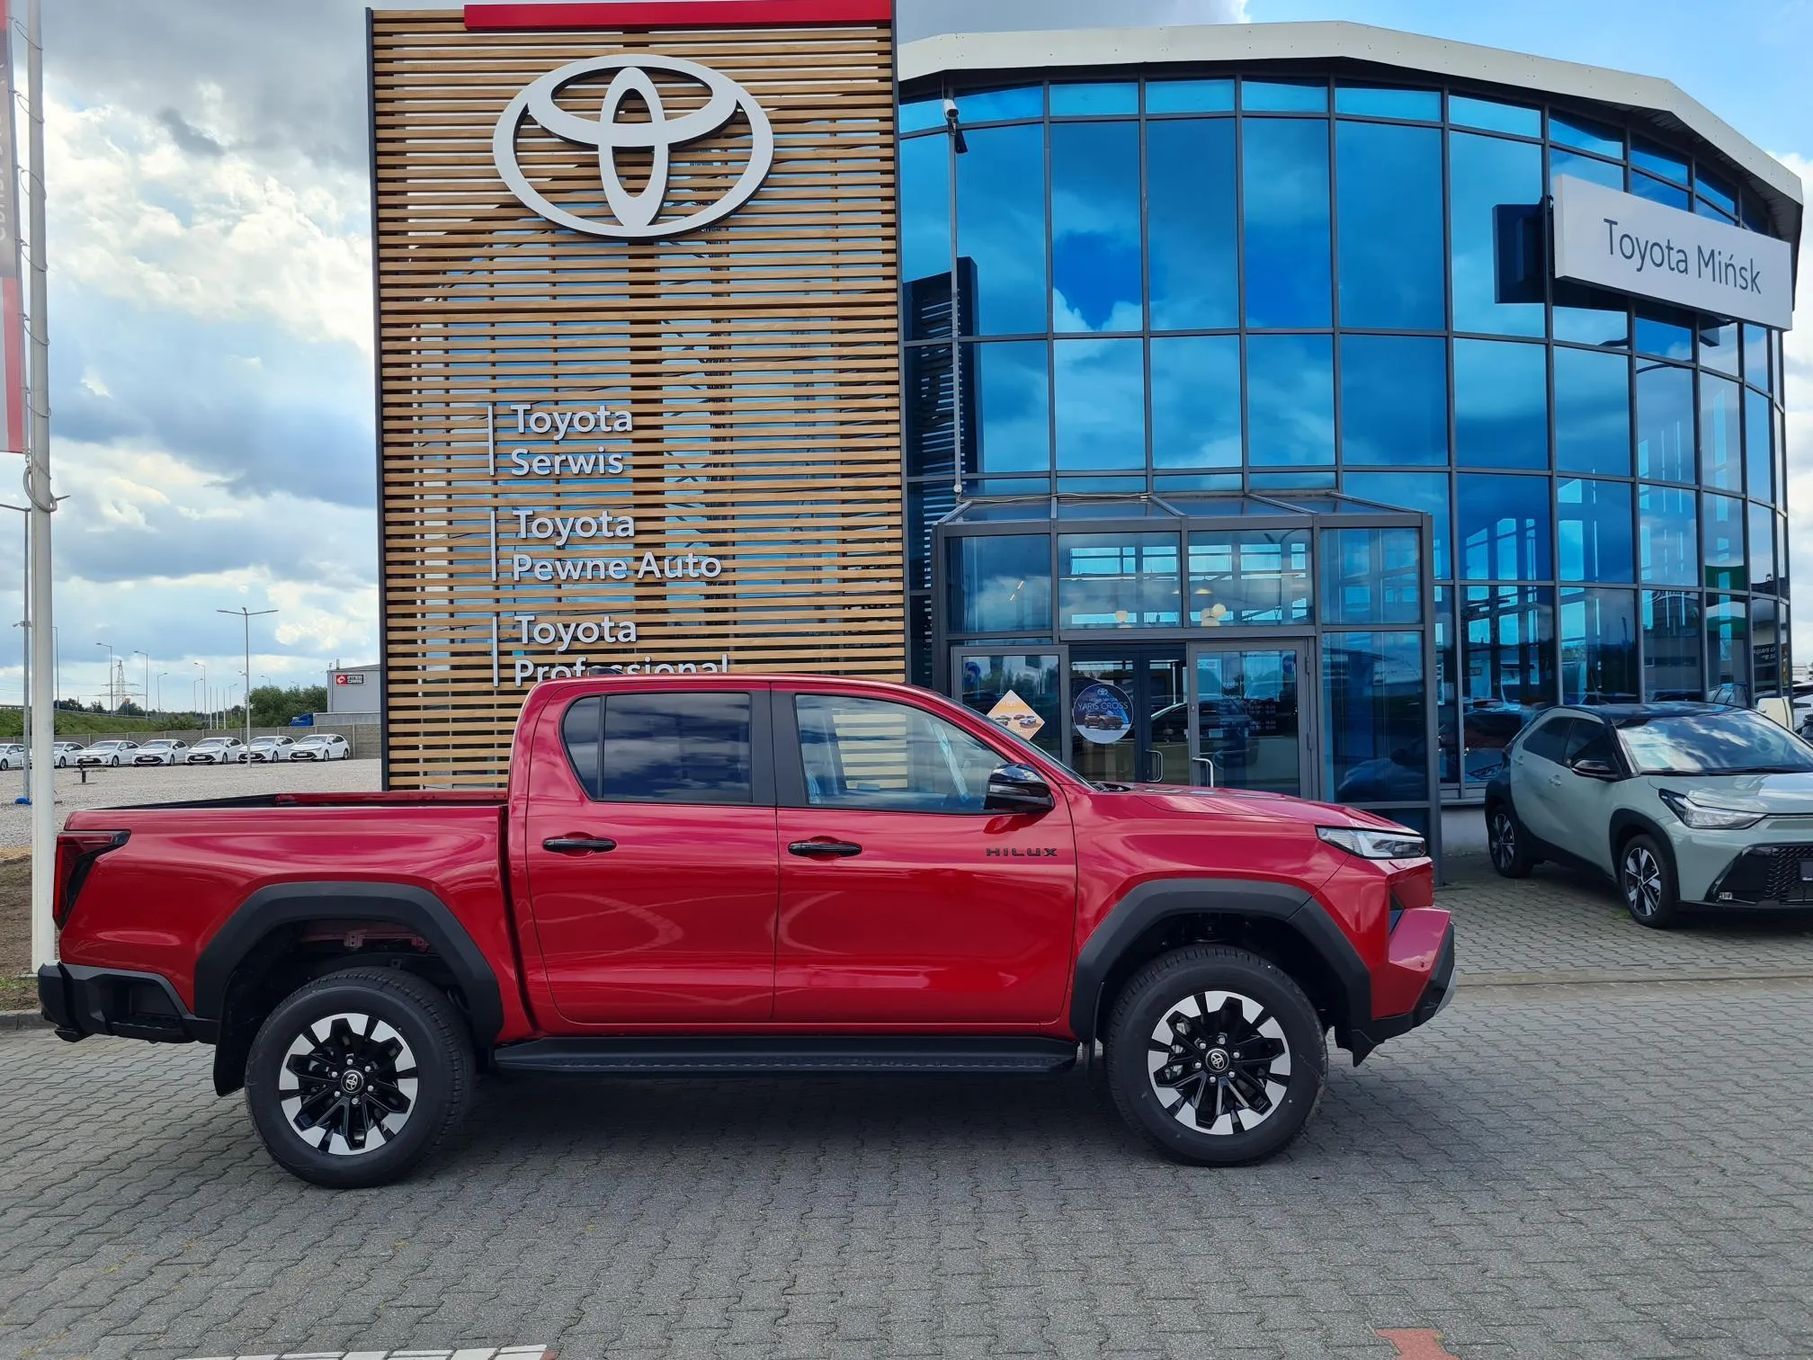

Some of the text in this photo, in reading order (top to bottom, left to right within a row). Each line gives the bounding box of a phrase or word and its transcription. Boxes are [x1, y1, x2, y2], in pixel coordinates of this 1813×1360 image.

[1603, 217, 1762, 295] Toyota Mińsk
[510, 404, 634, 440] Toyota
[510, 446, 624, 476] Serwis
[512, 509, 636, 546] Toyota
[512, 551, 722, 582] Pewne Auto
[513, 615, 638, 651] Toyota
[514, 653, 728, 687] Profsional
[1078, 702, 1100, 710] YARIS
[985, 847, 1058, 857] HILUX
